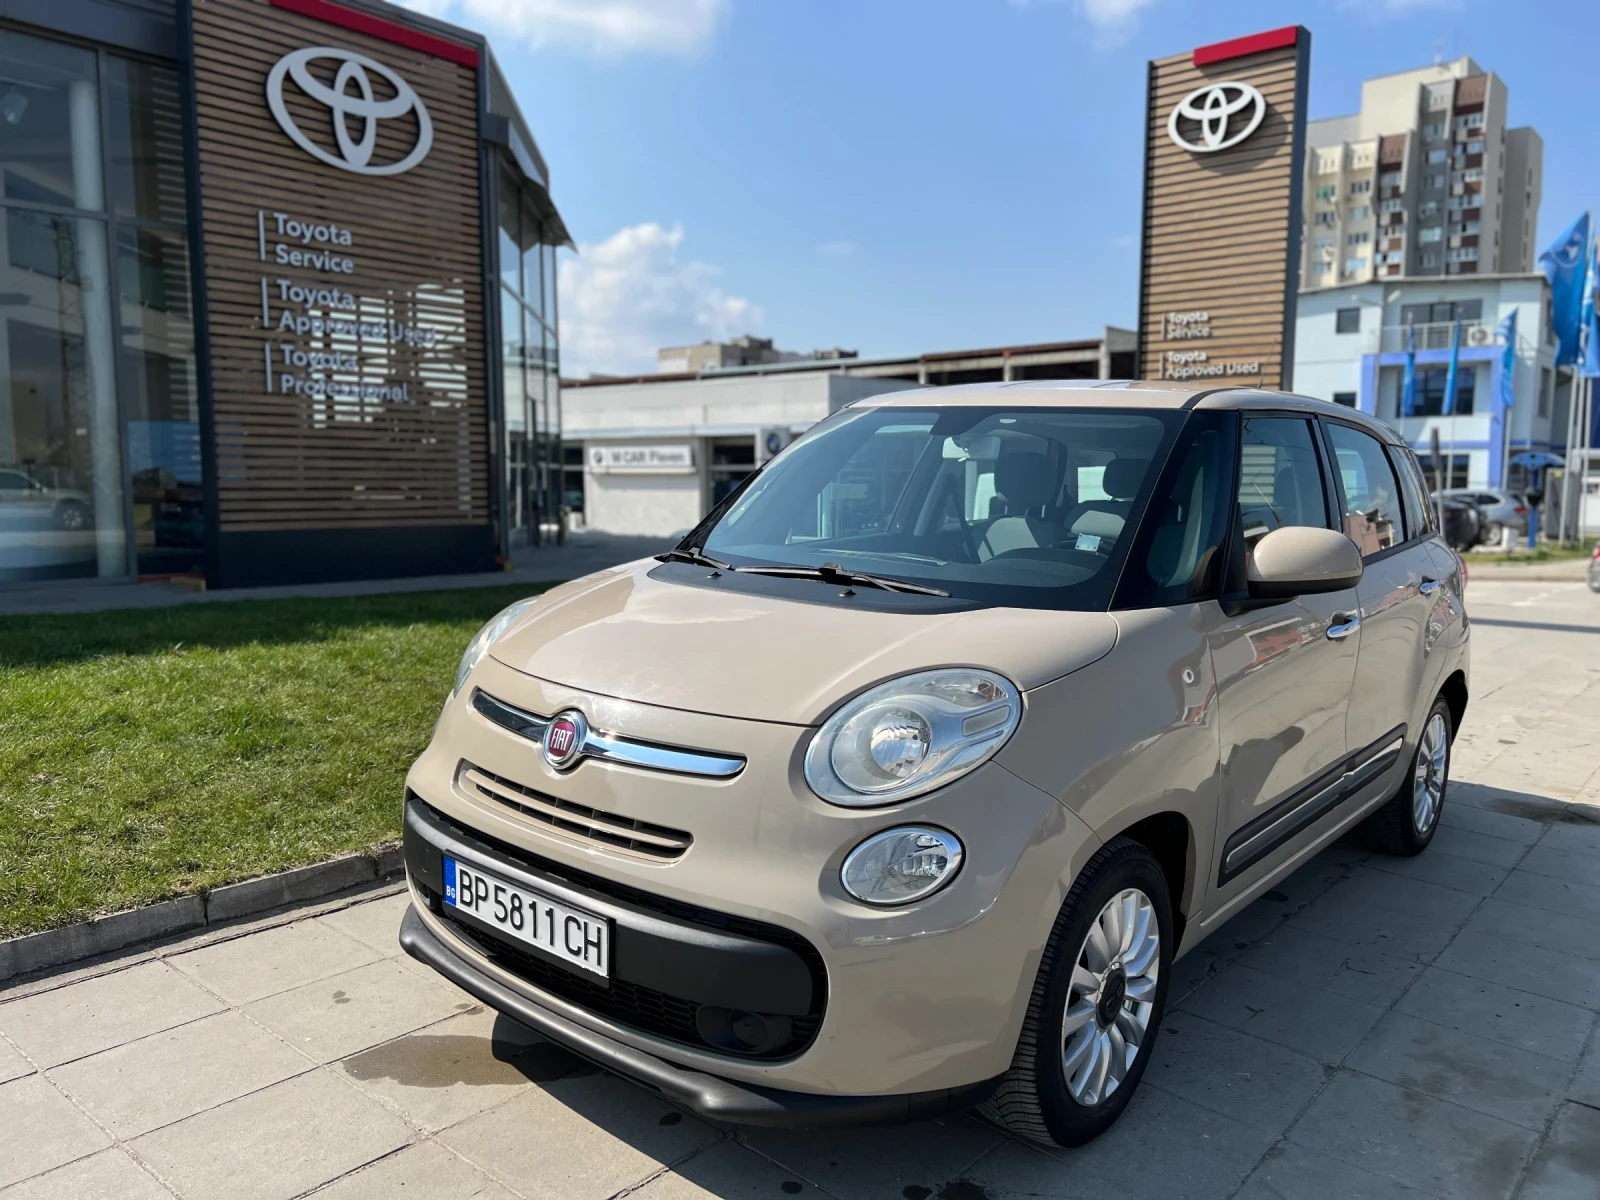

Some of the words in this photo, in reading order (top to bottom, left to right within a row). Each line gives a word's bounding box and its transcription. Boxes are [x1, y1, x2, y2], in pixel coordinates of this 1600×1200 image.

[273, 212, 353, 246] Toyota
[275, 244, 354, 273] Service
[276, 279, 356, 310] Toyota
[279, 310, 383, 340] Approved
[388, 323, 437, 345] Used
[1169, 311, 1209, 324] Toyota
[1167, 326, 1211, 339] Service
[279, 344, 358, 373] Toyota
[1166, 364, 1224, 378] Approved
[1226, 361, 1260, 374] Used
[1167, 350, 1207, 364] Toyota
[281, 375, 409, 403] Professional
[550, 727, 573, 751] FIAT
[446, 885, 456, 899] BG
